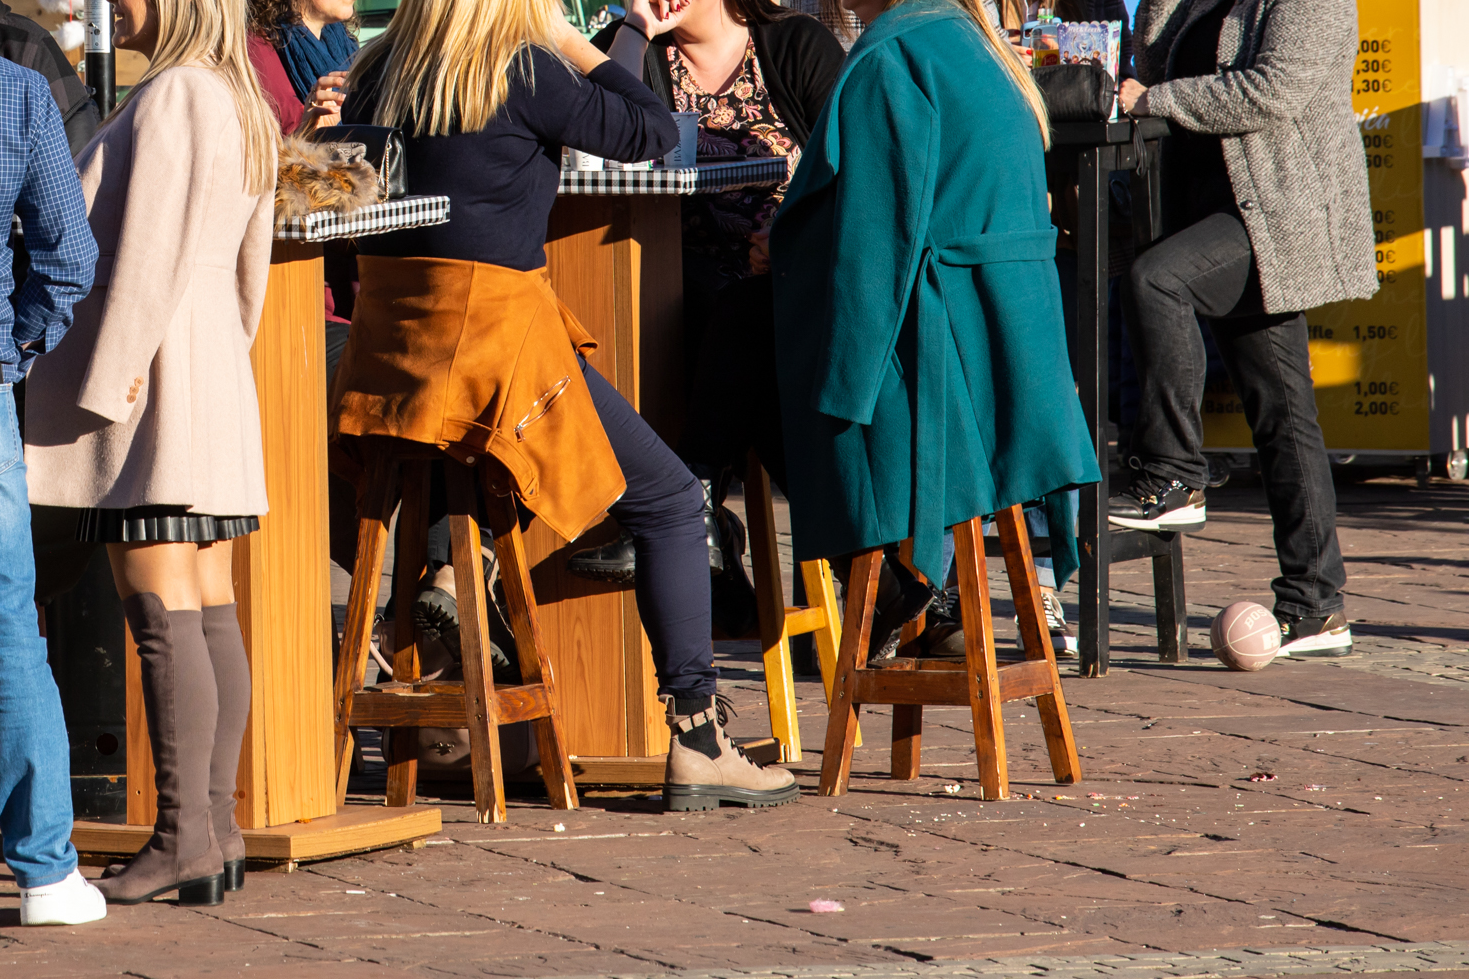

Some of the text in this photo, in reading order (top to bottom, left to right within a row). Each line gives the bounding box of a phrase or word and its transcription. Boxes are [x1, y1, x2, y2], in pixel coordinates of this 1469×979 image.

[1356, 39, 1393, 56] ,00€
[1356, 59, 1393, 75] ,30€
[1353, 325, 1399, 342] 1,50€
[1354, 381, 1400, 398] 1,00€
[1205, 400, 1400, 418] Bade 2,00€
